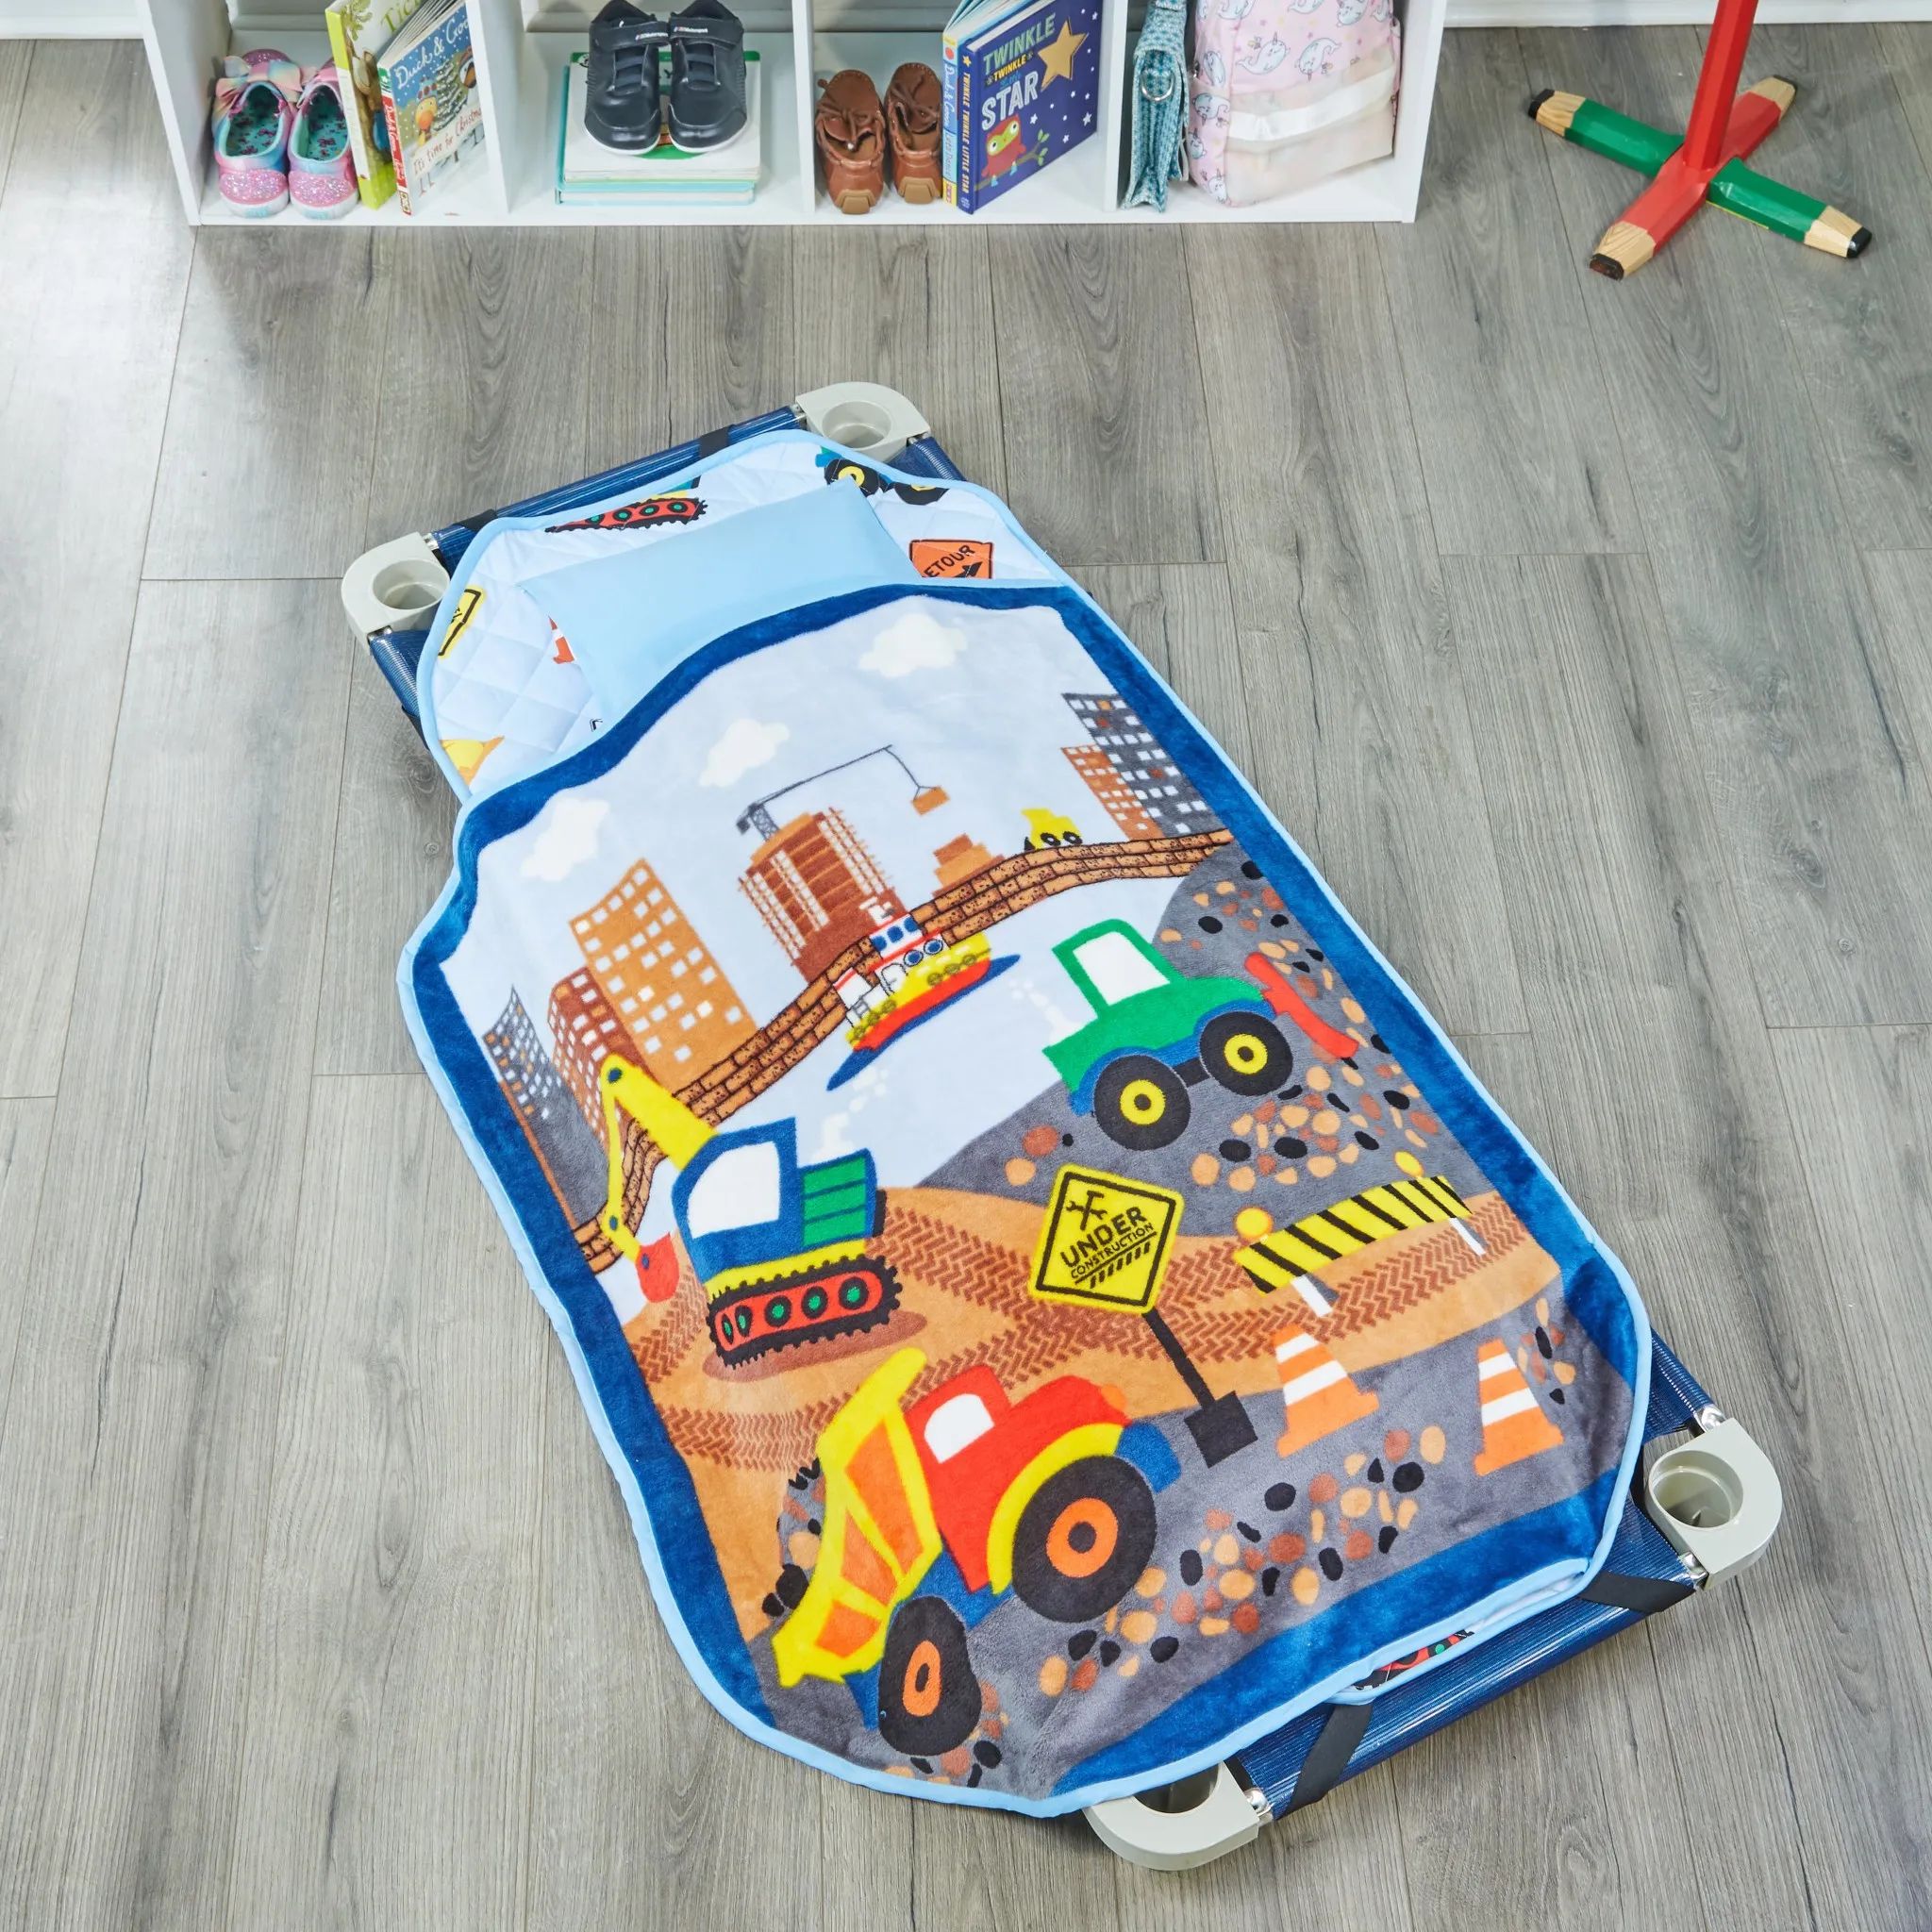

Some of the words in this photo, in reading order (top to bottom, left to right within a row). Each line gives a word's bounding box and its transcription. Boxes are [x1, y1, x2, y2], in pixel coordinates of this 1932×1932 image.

[395, 46, 434, 90] Duck
[434, 36, 445, 57] &
[983, 12, 1056, 75] TWINKLE
[993, 54, 1027, 82] TWINKLE
[962, 109, 971, 144] TWINKLE
[981, 71, 1039, 131] STAR
[923, 544, 975, 578] ETOUR
[1059, 1207, 1149, 1268] UNDER
[1071, 1223, 1154, 1280] CONSTRUCTION
